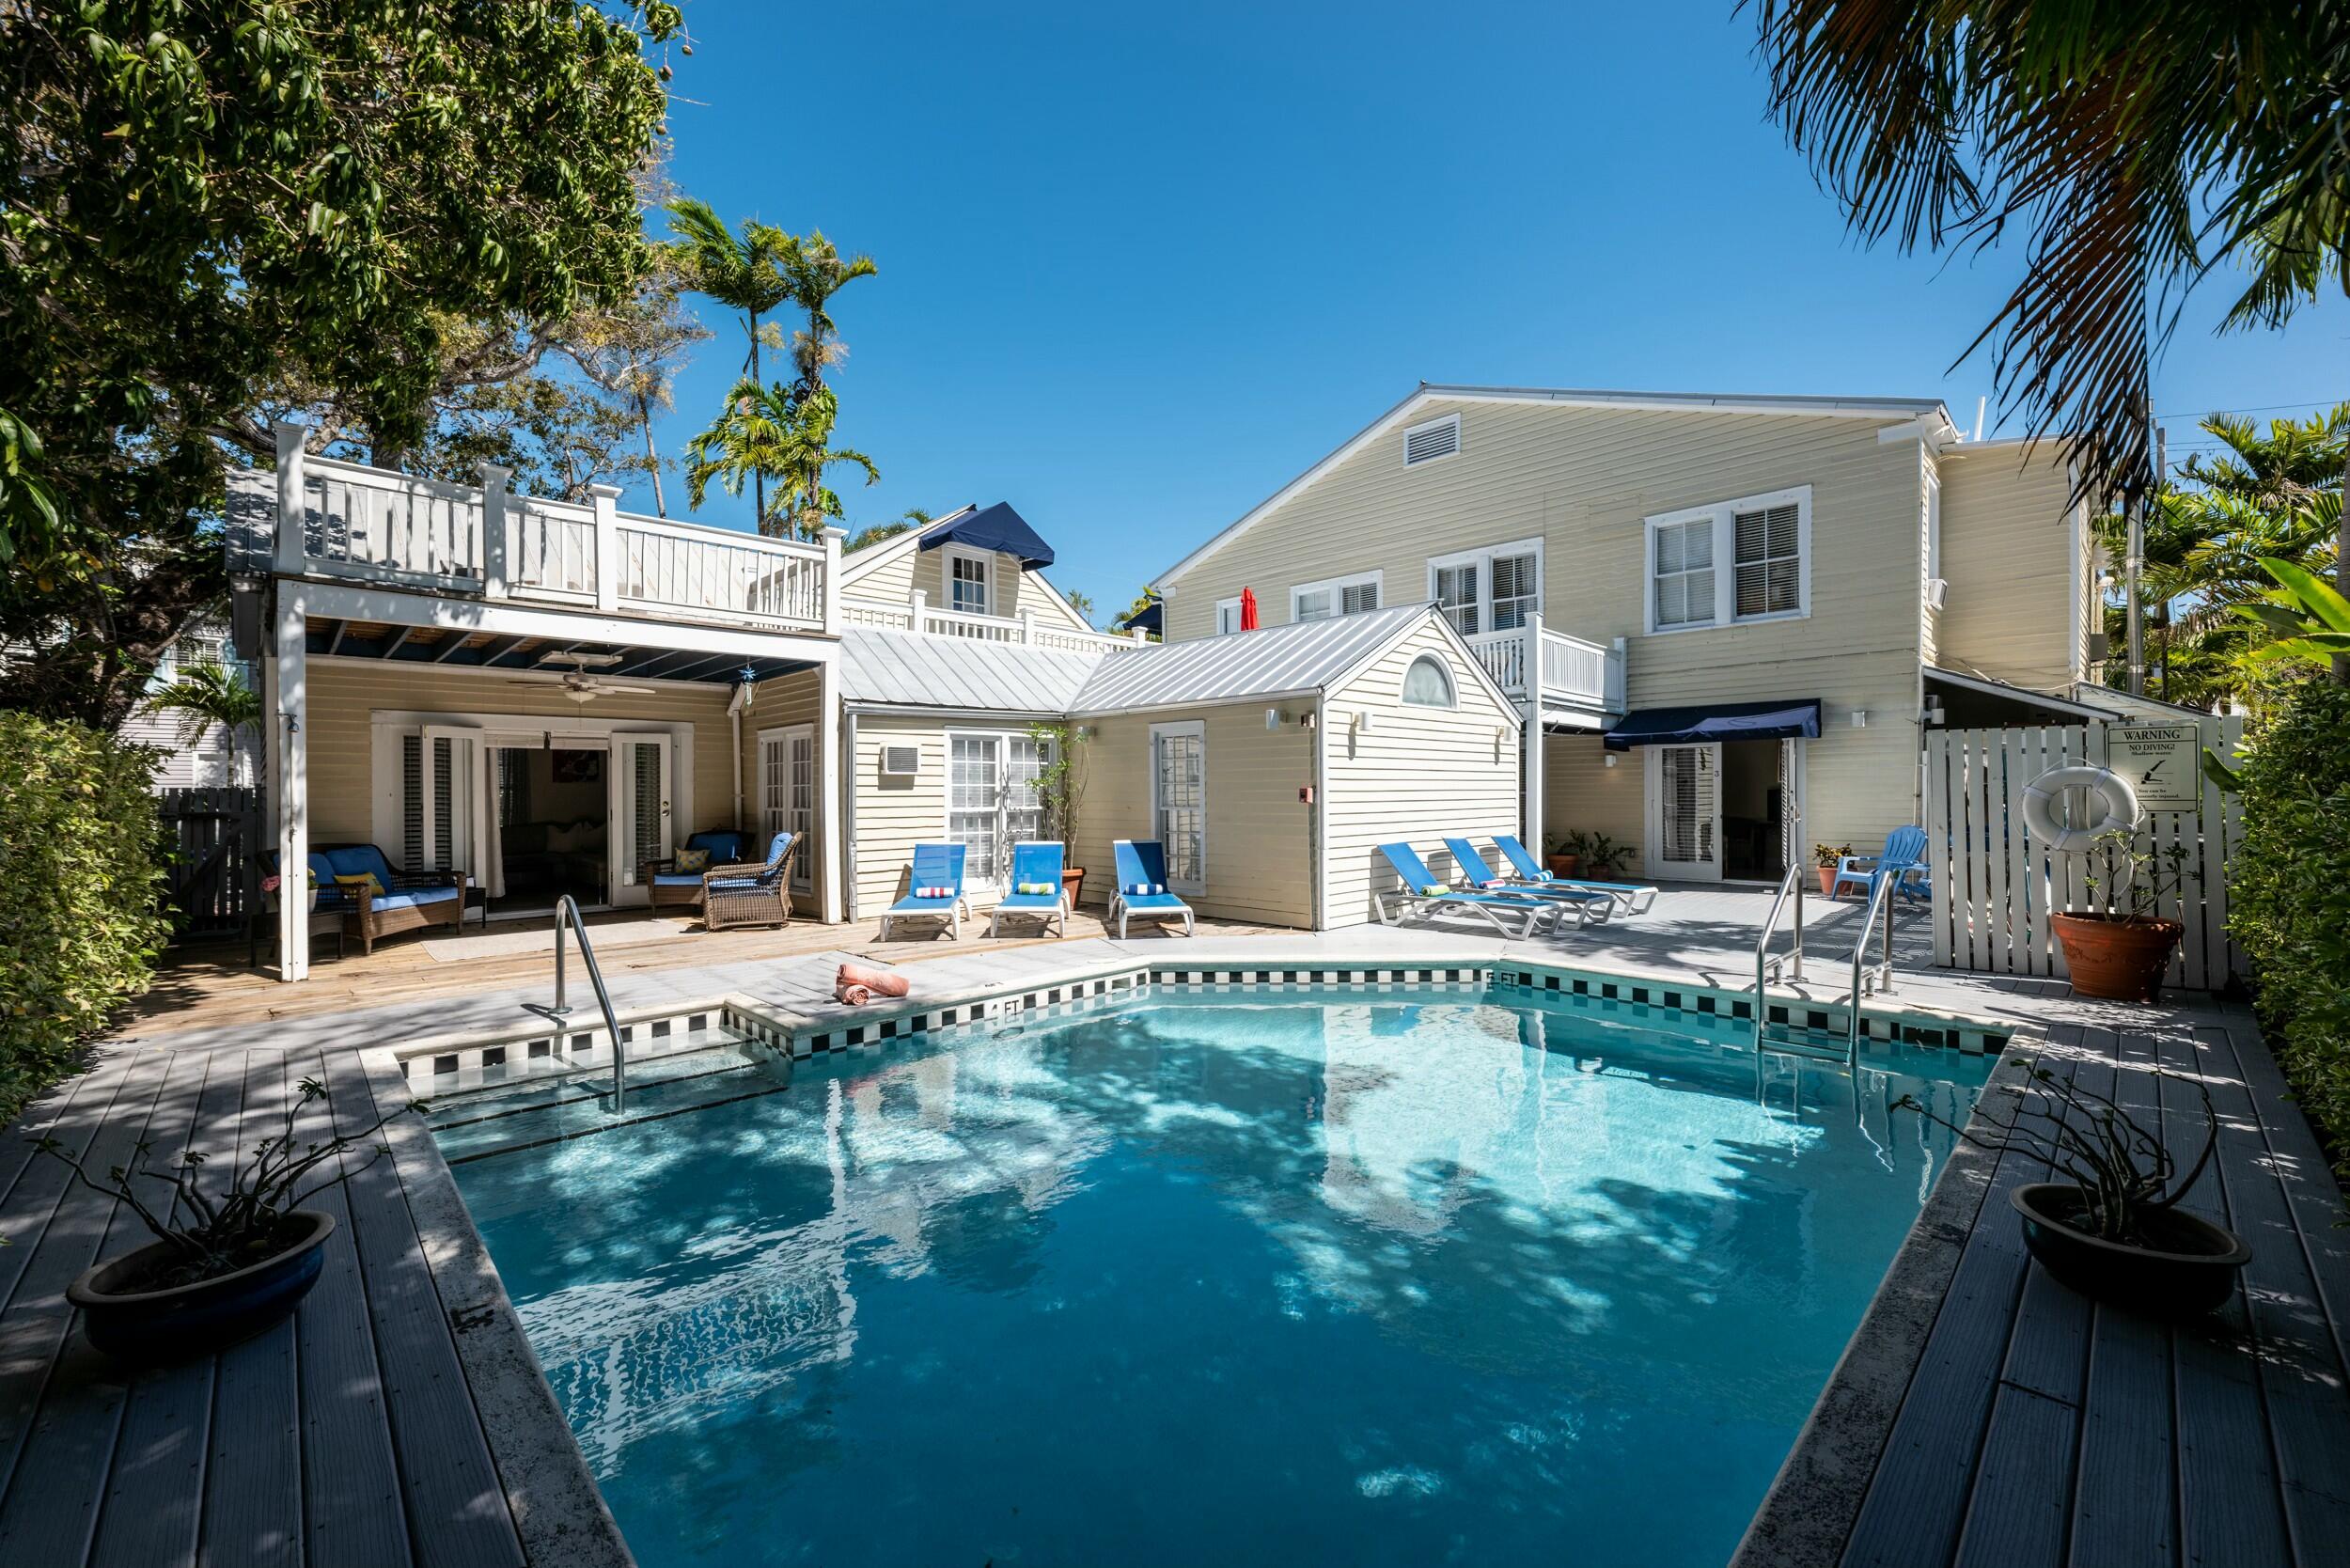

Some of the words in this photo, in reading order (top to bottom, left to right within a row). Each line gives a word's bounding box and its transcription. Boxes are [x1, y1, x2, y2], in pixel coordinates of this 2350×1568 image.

[2123, 729, 2180, 741] WARNING
[1502, 972, 1516, 984] FT
[1004, 999, 1019, 1015] FT
